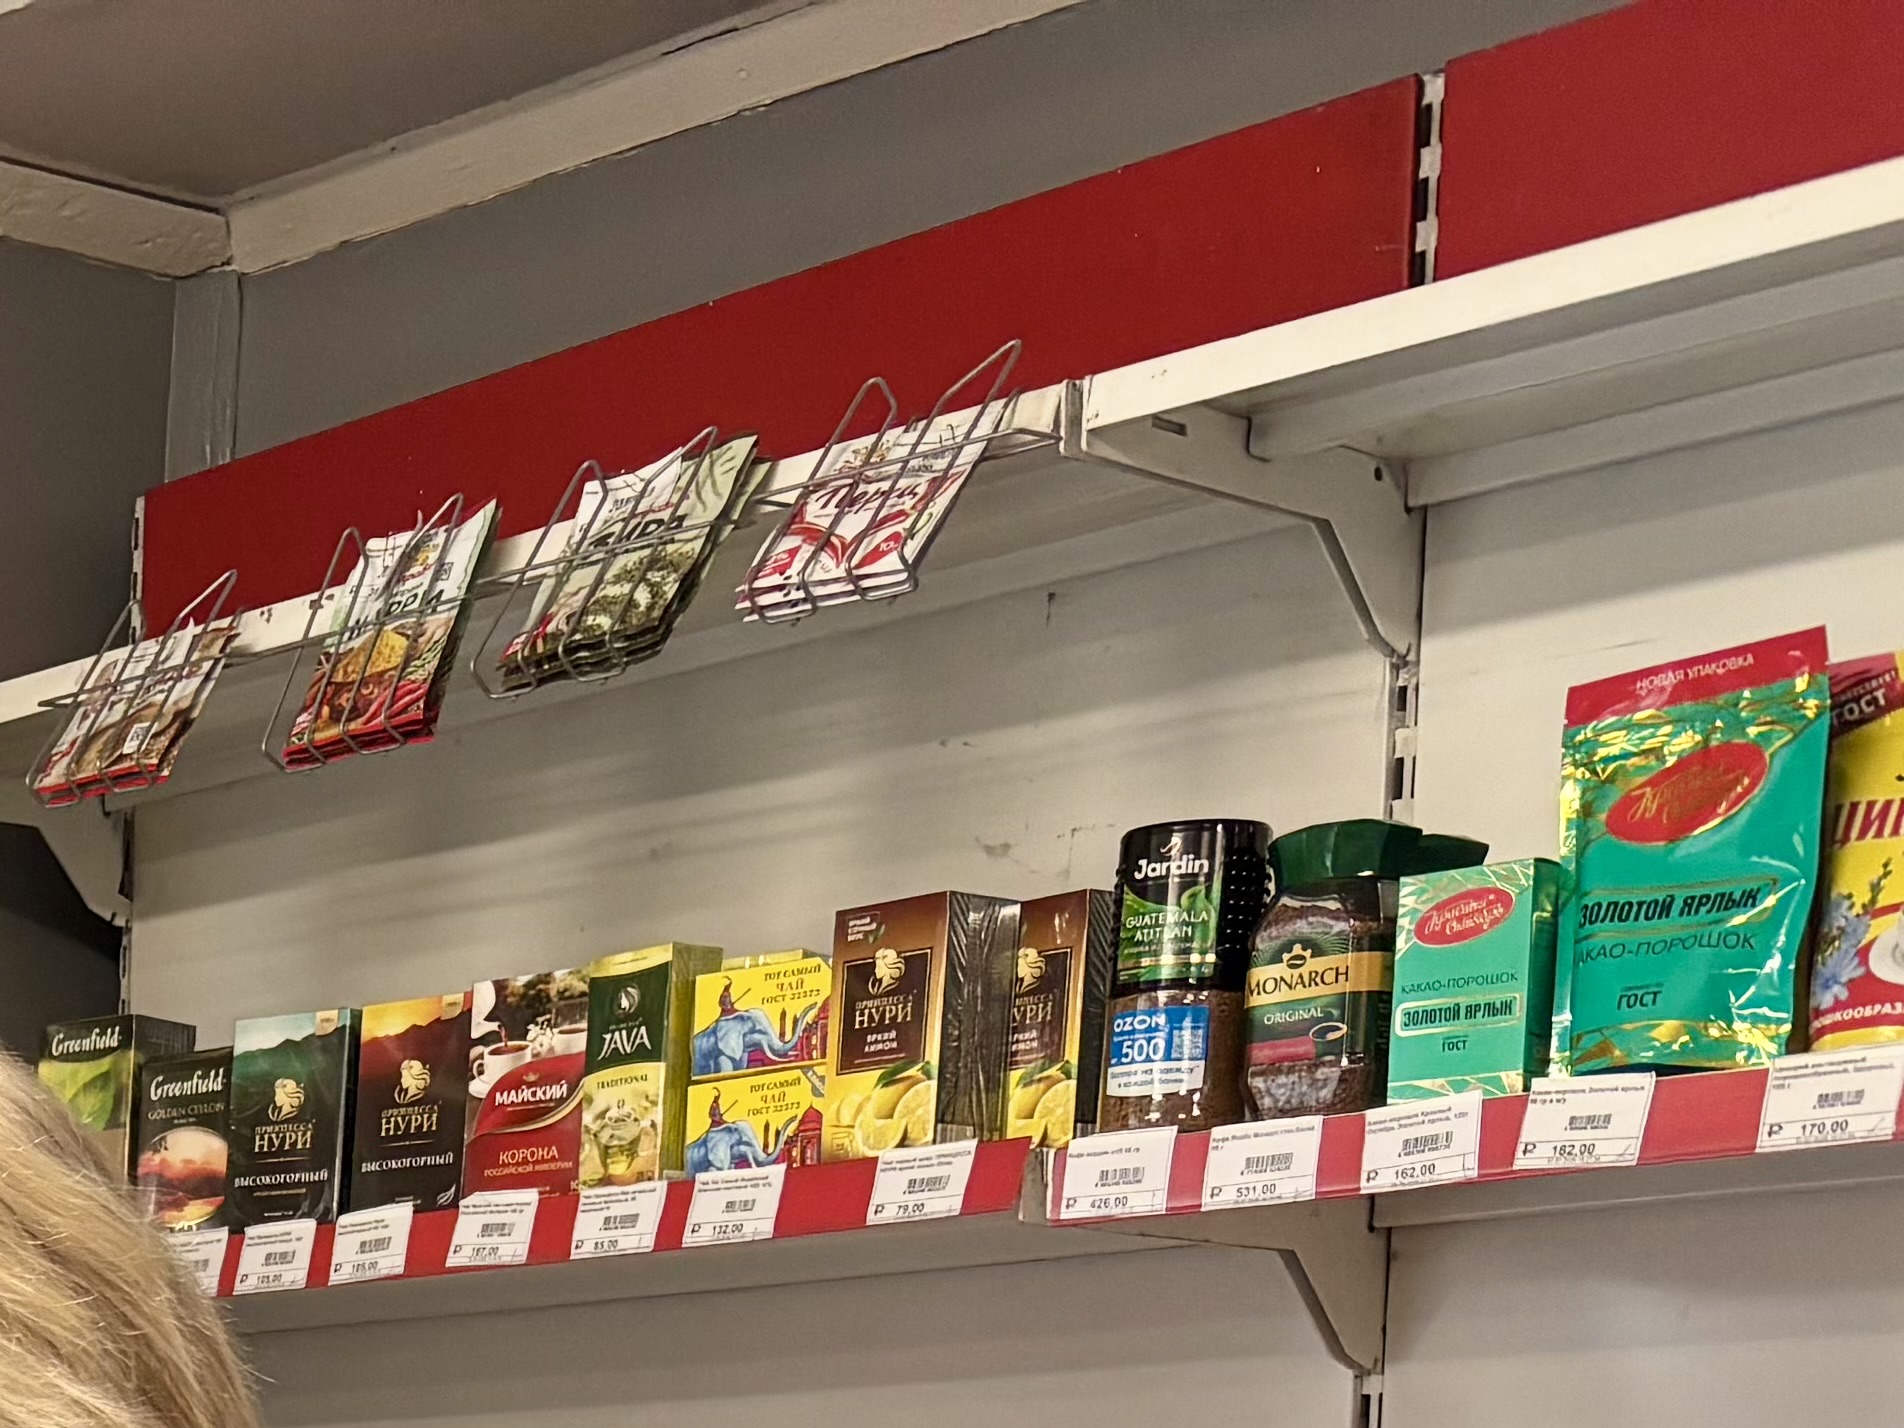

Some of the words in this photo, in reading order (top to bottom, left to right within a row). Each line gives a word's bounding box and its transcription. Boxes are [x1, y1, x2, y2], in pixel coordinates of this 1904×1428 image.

[1635, 665, 1686, 690] НОВАЯ
[1687, 652, 1755, 680] УПАКОВКА
[1133, 854, 1210, 880] Jardin
[1125, 910, 1209, 929] GUATEMALA
[1578, 894, 1674, 929] ЗОЛОТОЙ
[1678, 886, 1763, 918] ЯРЛЫК
[775, 978, 805, 993] ЧАЙ
[1246, 965, 1350, 998] MONARCH
[1401, 971, 1519, 995] КАКАО-ПОРОШОК
[1616, 988, 1661, 1012] ГОСТ
[854, 1003, 912, 1030] НУРИ
[1011, 1003, 1053, 1027] УРИ
[1113, 1013, 1167, 1031] OZON
[1263, 1006, 1324, 1025] ORIGINAL
[1403, 1004, 1461, 1028] ЗОЛОТОЙ
[1464, 999, 1513, 1021] ЯРЛЫК
[51, 1025, 120, 1057] Greenfield
[597, 1024, 653, 1061] JAVA
[1441, 1039, 1468, 1053] ГОСТ
[149, 1067, 225, 1101] Greenfield
[494, 1079, 568, 1107] МАЙСКИЙ
[759, 1091, 787, 1104] ЧАЙ
[379, 1113, 438, 1137] НУРИ
[1800, 1119, 1849, 1136] 170,00
[254, 1131, 313, 1153] НУРИ
[499, 1145, 559, 1166] КОРОНА
[1394, 1163, 1437, 1180] 162,00
[896, 1202, 925, 1216] 79,00
